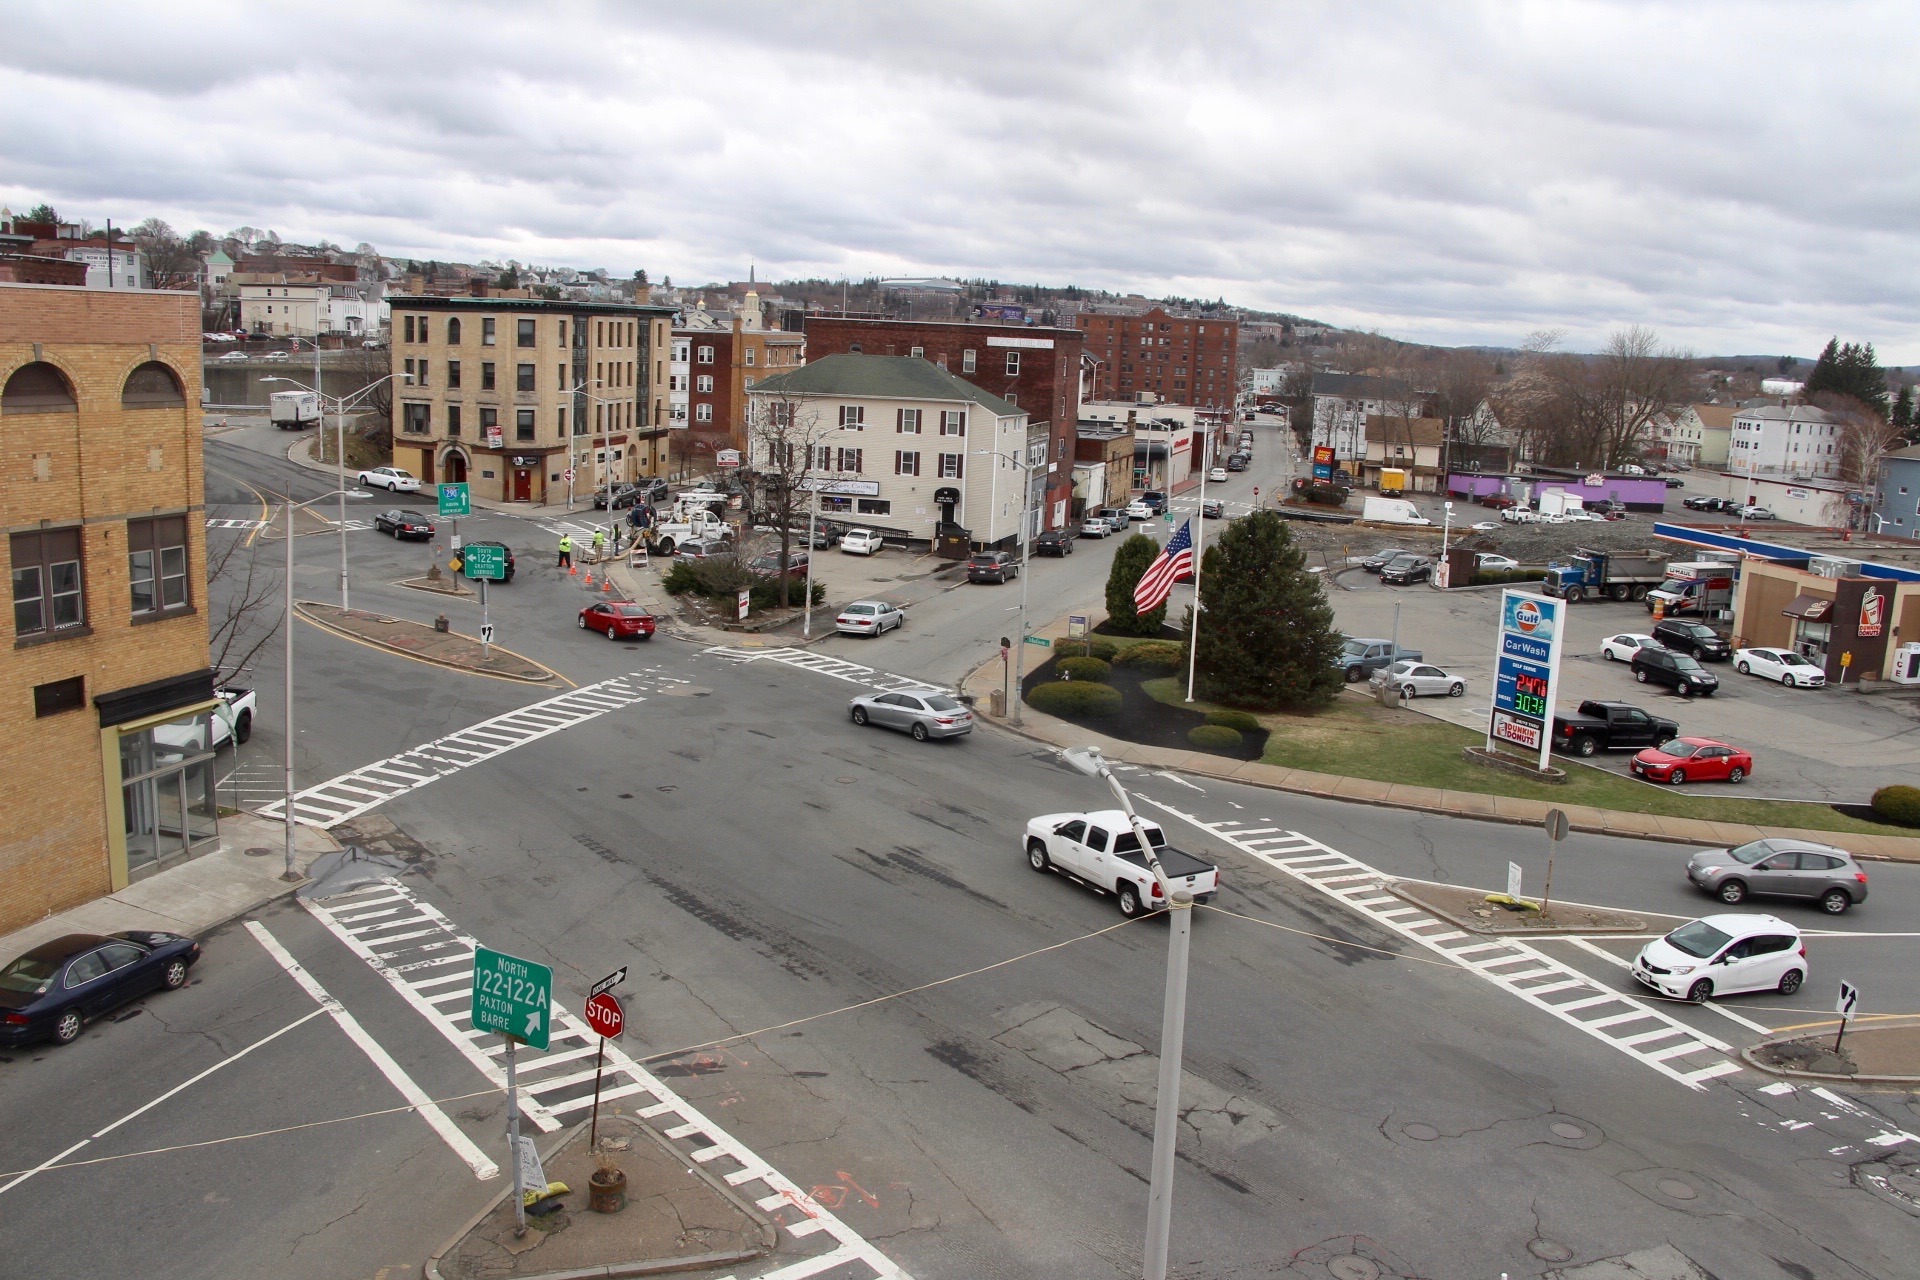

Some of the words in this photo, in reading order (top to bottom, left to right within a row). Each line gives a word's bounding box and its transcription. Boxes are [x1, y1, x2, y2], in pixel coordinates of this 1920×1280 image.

[446, 489, 457, 497] 290
[477, 554, 492, 563] 122
[1669, 568, 1692, 577] U-HAUL
[1516, 610, 1540, 625] Gulf
[1512, 662, 1523, 670] SELF
[1523, 664, 1537, 673] SERVE
[1895, 652, 1903, 677] ICE
[1498, 673, 1517, 682] REGULAR
[1497, 693, 1512, 702] DIESEL
[1506, 723, 1537, 738] DUNKIN'
[1515, 718, 1528, 726] DRIVE
[1528, 722, 1540, 730] THRU
[1506, 731, 1534, 745] DONUTS
[497, 957, 528, 978] NORTH
[476, 967, 547, 1010] 122-122A
[593, 983, 604, 995] ONE
[605, 976, 616, 987] WAY
[480, 994, 513, 1015] PAXTON
[481, 1011, 510, 1031] BARRE
[587, 1001, 621, 1028] STOP
